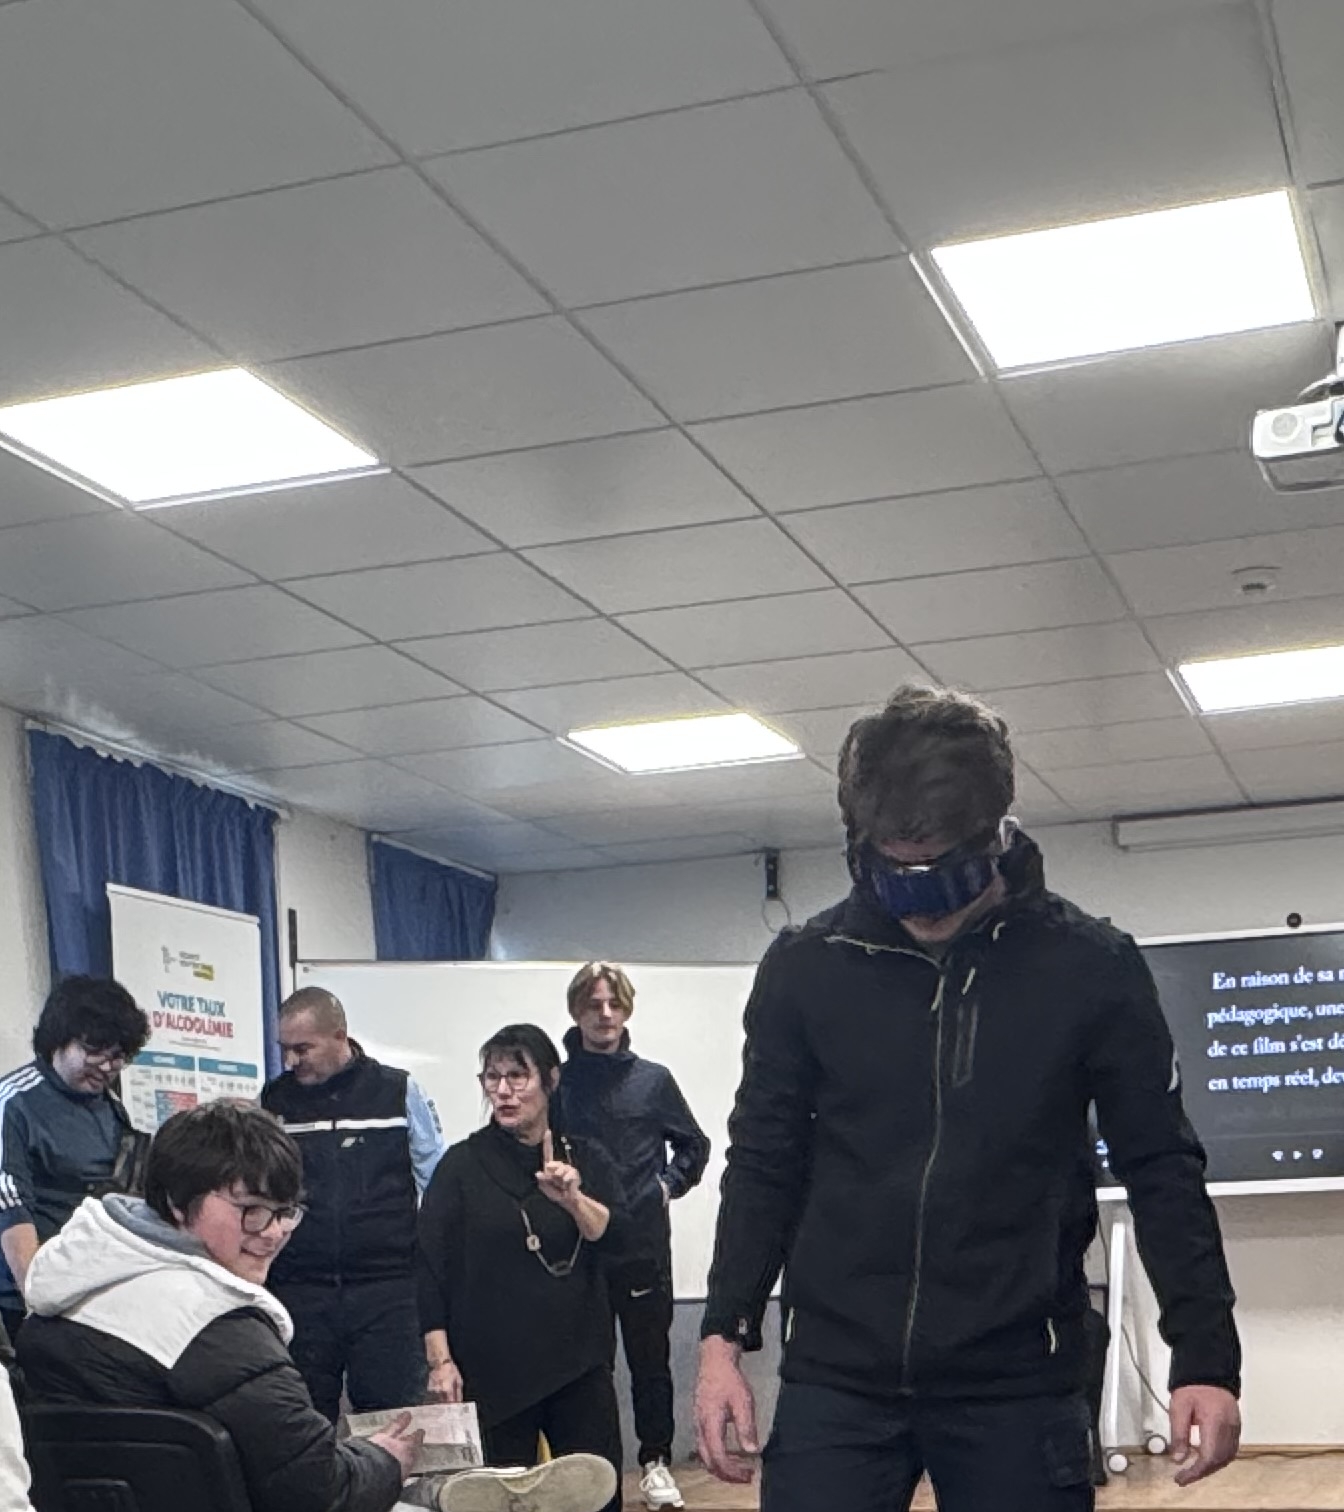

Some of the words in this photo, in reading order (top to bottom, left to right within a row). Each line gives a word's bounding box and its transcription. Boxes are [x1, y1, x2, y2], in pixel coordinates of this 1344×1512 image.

[1212, 972, 1236, 990] En
[1241, 970, 1290, 988] raison
[1293, 965, 1314, 984] de
[1316, 969, 1335, 982] sa
[157, 990, 195, 1013] VOTRE
[196, 996, 226, 1018] TAUX
[1206, 1003, 1314, 1029] pédagogique,
[1207, 1040, 1227, 1058] de
[1230, 1043, 1248, 1056] ce
[1252, 1036, 1286, 1056] film
[1289, 1033, 1324, 1052] s'est
[1208, 1077, 1229, 1092] en
[1232, 1073, 1281, 1093] temps
[1284, 1067, 1320, 1087] réel,
